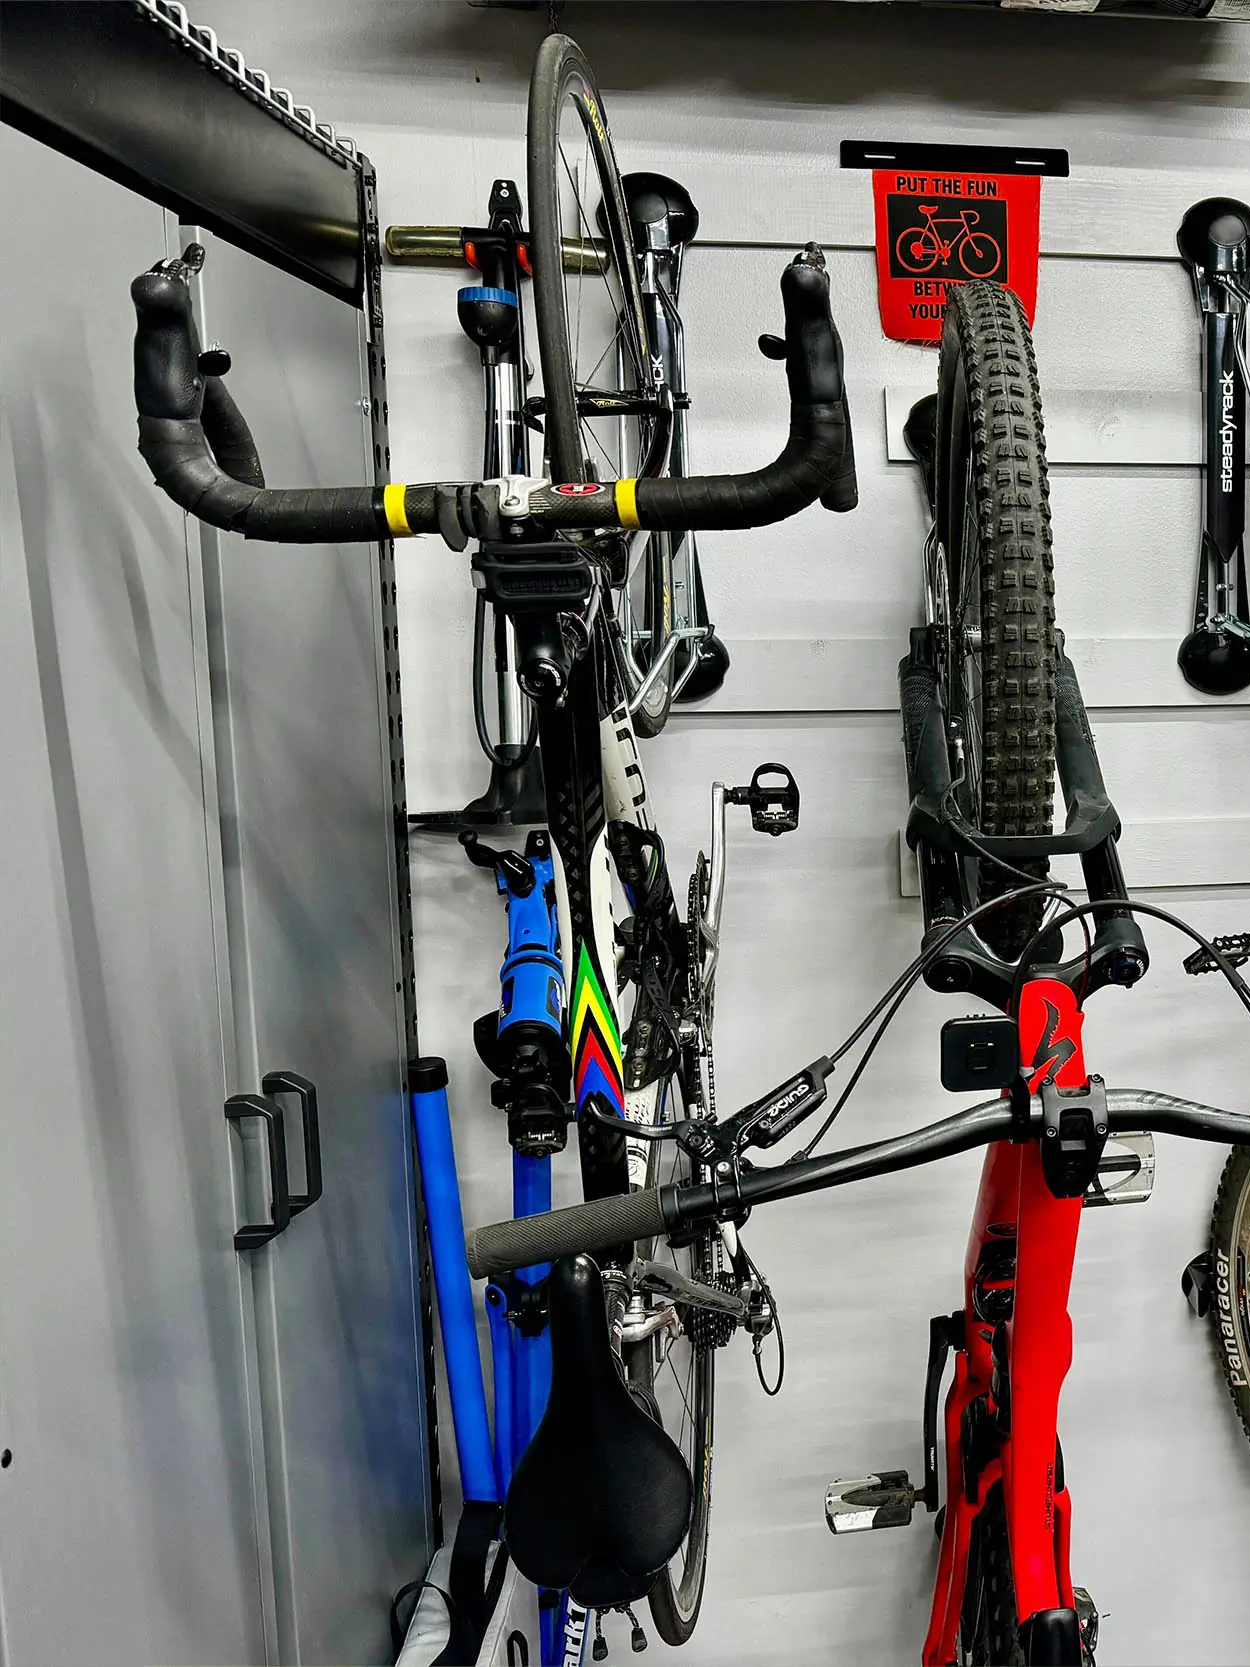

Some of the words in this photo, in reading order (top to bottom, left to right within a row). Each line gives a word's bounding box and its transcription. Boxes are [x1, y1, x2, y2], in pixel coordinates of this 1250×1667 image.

[897, 176, 927, 193] PUT
[932, 178, 962, 195] THE
[967, 181, 997, 196] FUN
[1219, 370, 1237, 492] steadyrack
[768, 1083, 810, 1117] GUIDE
[1216, 1248, 1248, 1387] Panaracer
[562, 1612, 585, 1667] ark
